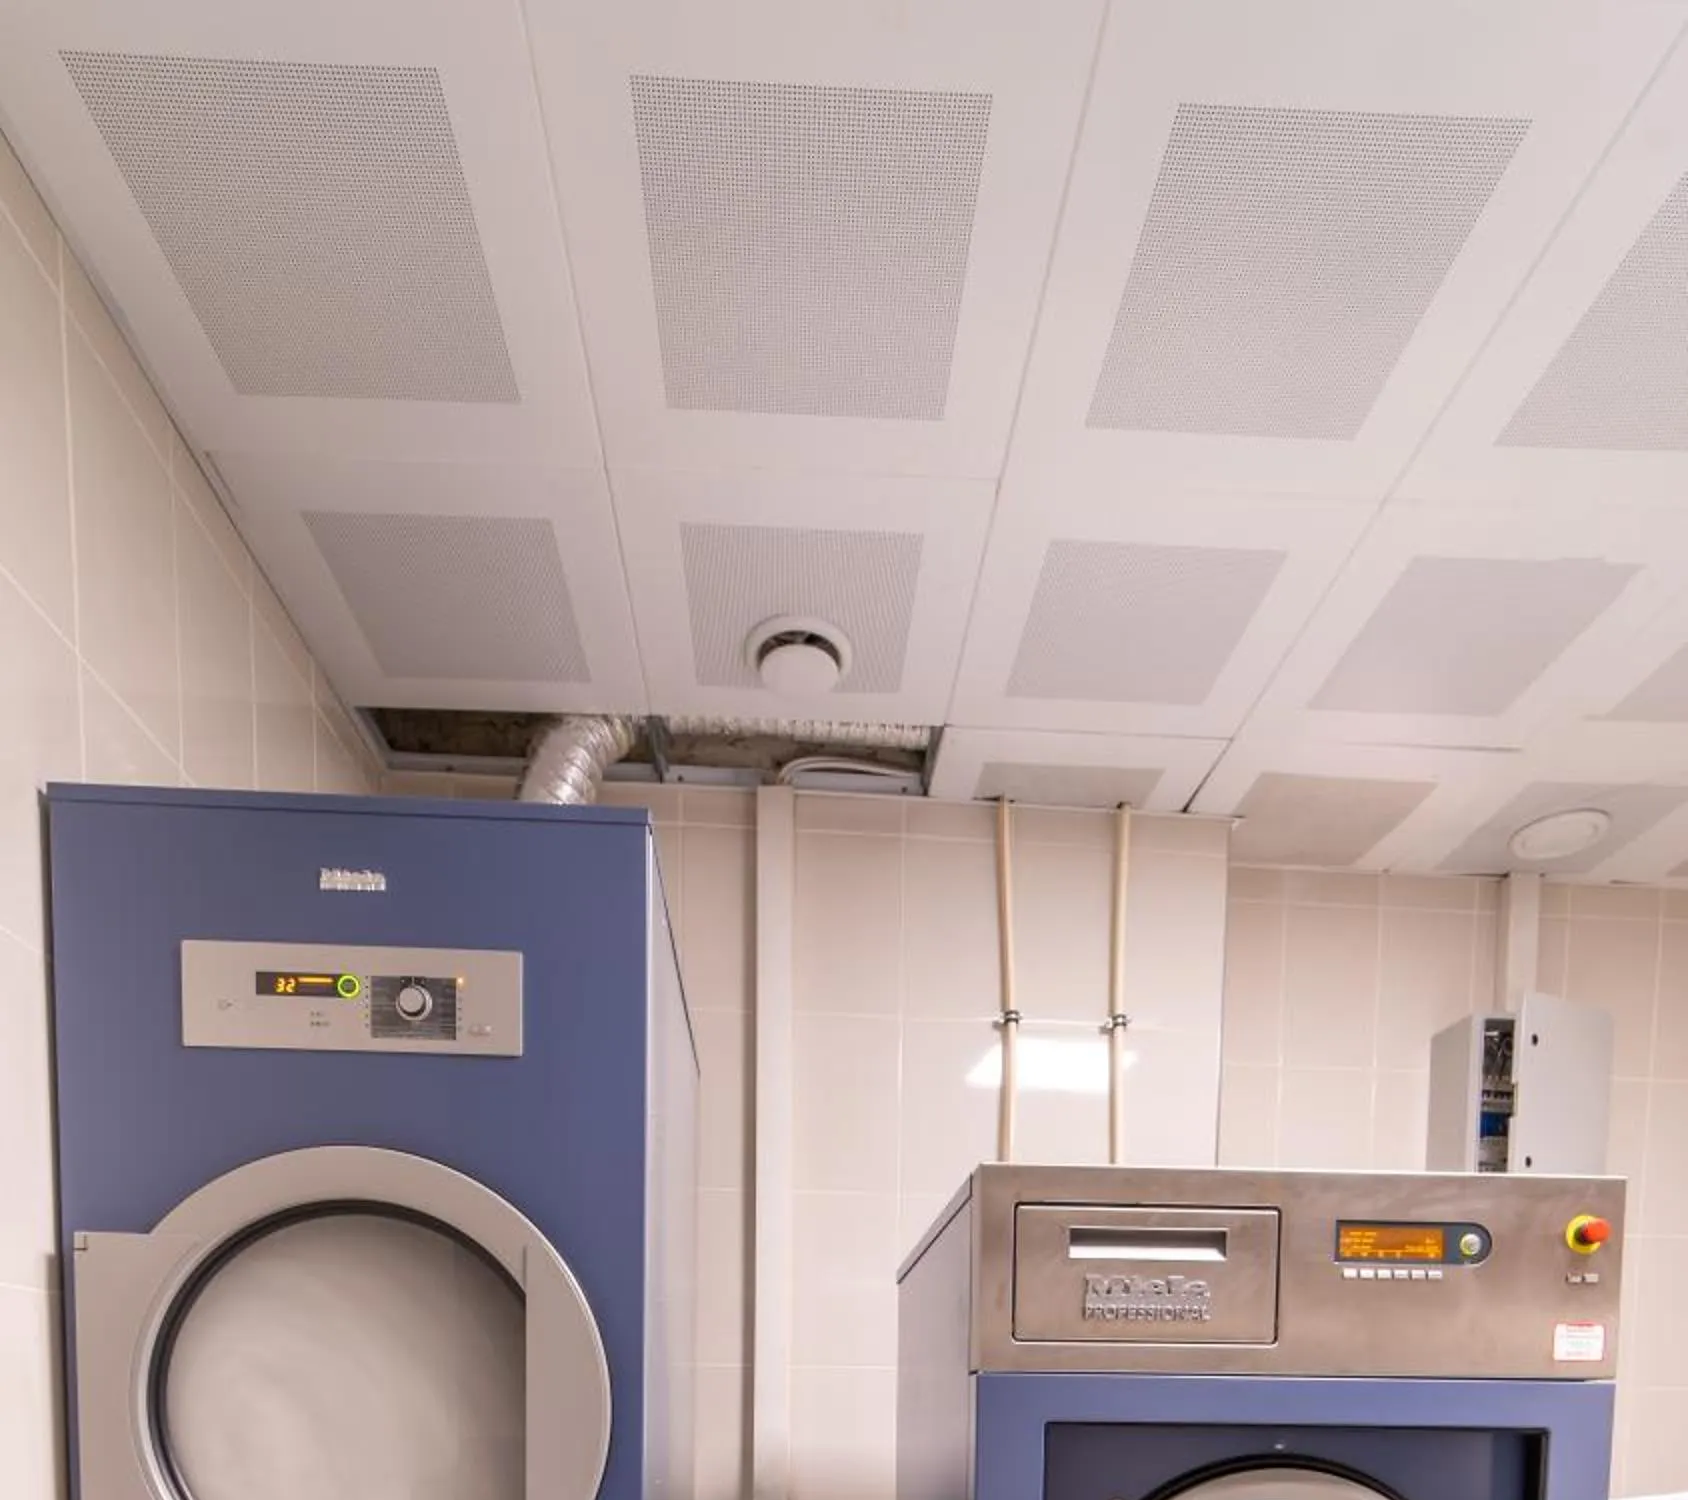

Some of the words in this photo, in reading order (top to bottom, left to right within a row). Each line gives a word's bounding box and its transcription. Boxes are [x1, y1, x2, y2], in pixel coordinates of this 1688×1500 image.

[275, 977, 296, 993] 32
[1084, 1274, 1210, 1297] Miele
[1083, 1302, 1211, 1321] PROFESSIONAL
